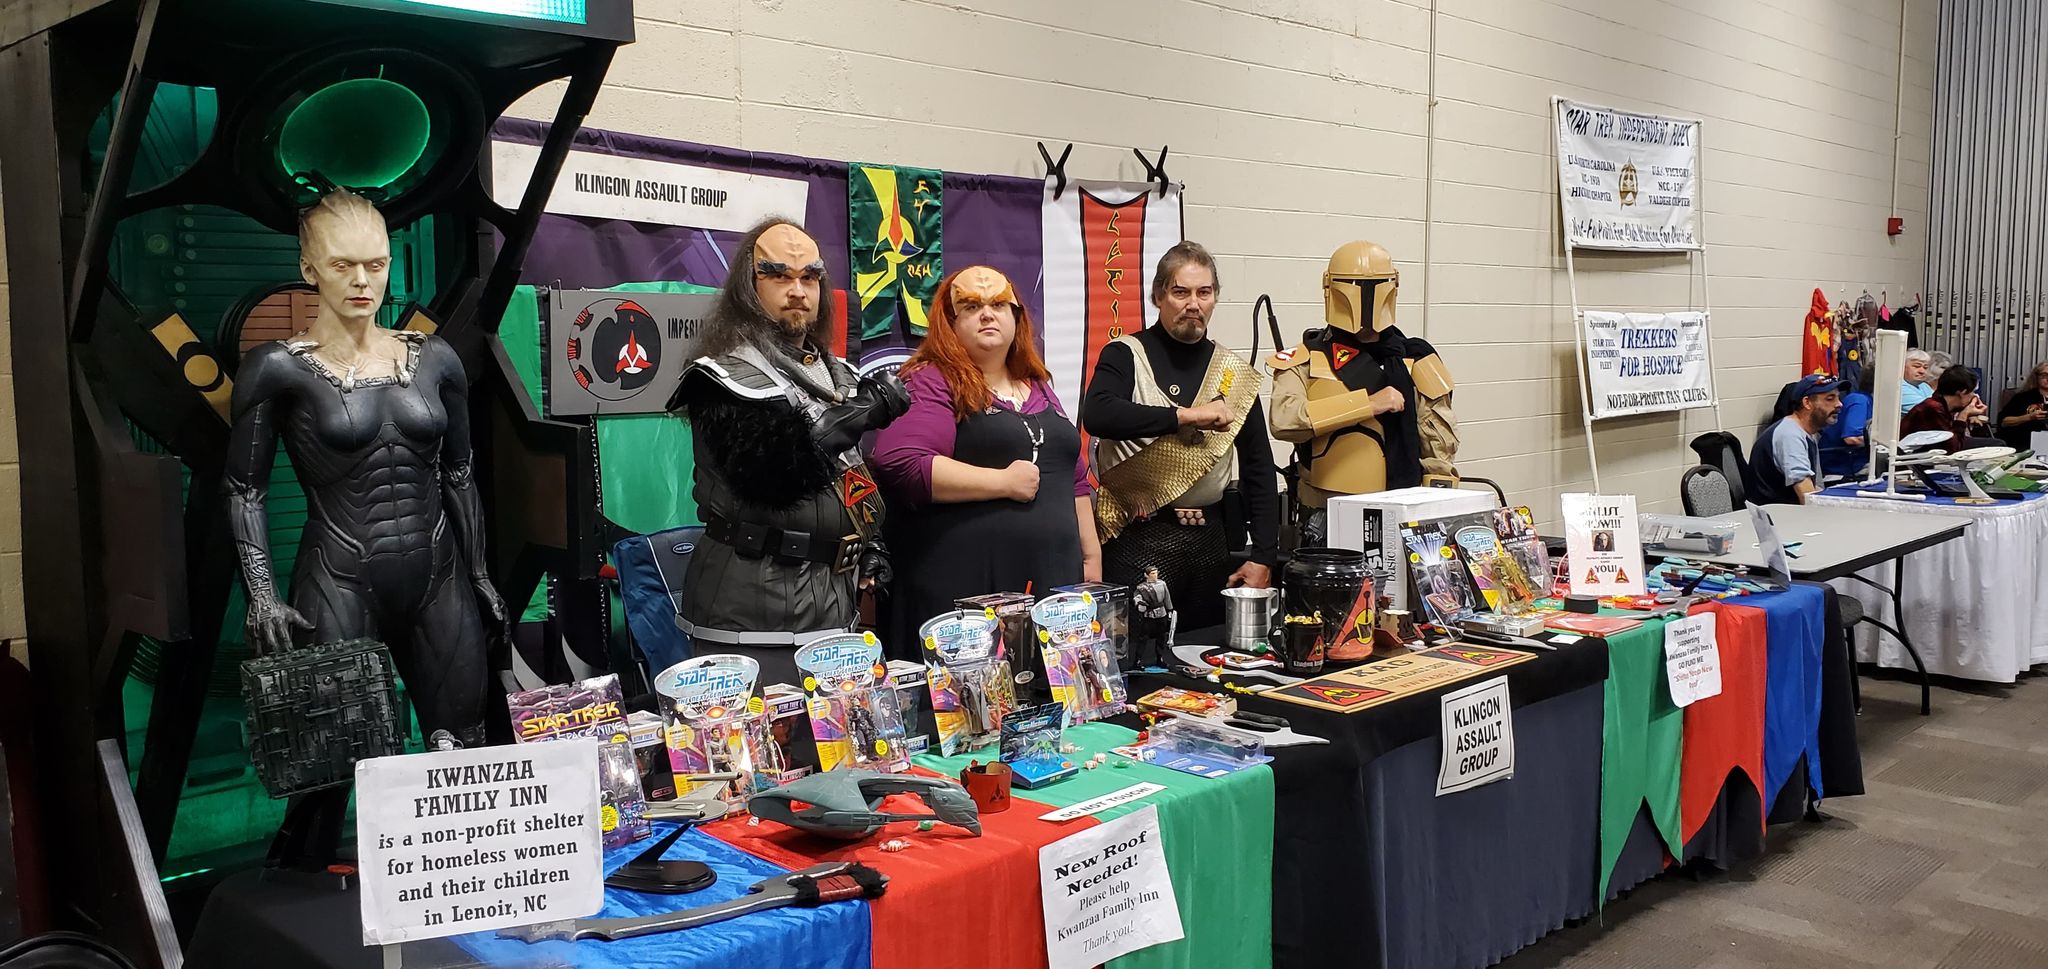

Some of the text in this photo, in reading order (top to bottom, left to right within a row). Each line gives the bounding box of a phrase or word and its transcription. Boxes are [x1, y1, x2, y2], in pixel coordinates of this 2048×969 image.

[1566, 108, 1591, 136] STAR
[1594, 112, 1614, 140] TREK
[1618, 116, 1669, 146] INDEPENDENT
[1591, 159, 1616, 173] CAROLINA
[575, 172, 727, 209] KLINGON ASSAULT GROUP
[1621, 328, 1678, 349] TREKKERS
[1619, 356, 1640, 377] FOR
[1642, 355, 1684, 376] HOSPICE
[1666, 390, 1681, 404] FAN
[1682, 388, 1708, 403] CLUBS
[1594, 565, 1617, 573] YOU!
[1044, 605, 1065, 618] STAR
[811, 646, 840, 664] STAR
[840, 650, 872, 667] TREK
[1344, 660, 1414, 677] KAG
[674, 668, 709, 688] STAR
[708, 673, 744, 691] TREK
[521, 701, 620, 737] STAR TREK
[1453, 696, 1501, 730] KLINGON
[1456, 721, 1503, 754] ASSAULT
[426, 759, 535, 790] KWANZAA
[1459, 747, 1499, 776] GROUP
[414, 784, 548, 819] FAMILY INN
[1060, 810, 1081, 818] DO
[1080, 801, 1107, 812] NOT
[378, 834, 394, 850] is
[402, 835, 413, 847] a
[421, 819, 516, 845] non-profit
[524, 812, 584, 834] shelter
[387, 841, 578, 876] for homeless women
[1054, 831, 1147, 881] New Roof
[398, 868, 570, 902] and their children
[1066, 854, 1139, 897] Needed!
[424, 894, 547, 927] in Lenoir, NC
[1079, 880, 1130, 911] Please help
[1057, 891, 1159, 942] Kwanzaa Family Inn
[1083, 920, 1135, 954] Thank you!
